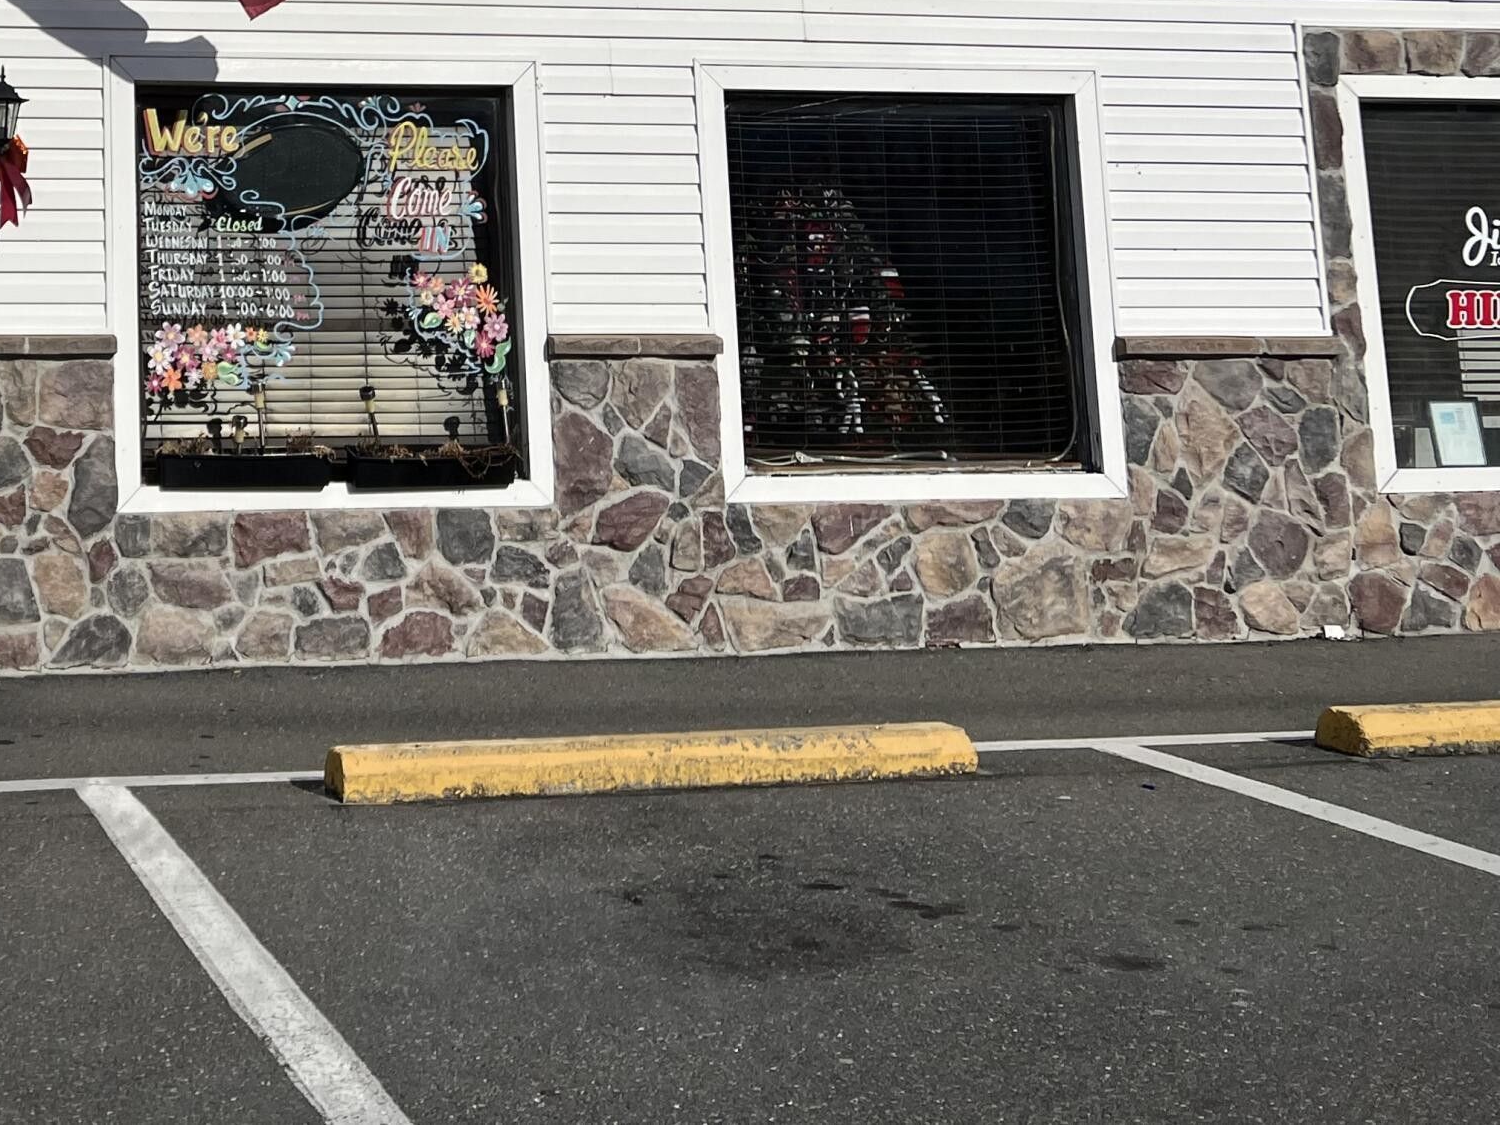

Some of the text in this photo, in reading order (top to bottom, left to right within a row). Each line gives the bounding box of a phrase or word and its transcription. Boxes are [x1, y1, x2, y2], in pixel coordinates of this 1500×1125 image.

[143, 108, 239, 155] We're
[388, 121, 479, 171] Please
[388, 176, 453, 220] Come
[143, 202, 188, 216] MONDAY
[142, 218, 192, 233] TUESDAY
[216, 216, 263, 231] Closed
[146, 236, 209, 249] WEDNESDAY
[419, 226, 452, 253] IN
[144, 249, 208, 264] THURSDAY
[148, 265, 194, 281] FRIDAY
[148, 282, 216, 299] SATURDAY
[150, 299, 207, 315] SUNDAY
[1446, 290, 1500, 328] HI
